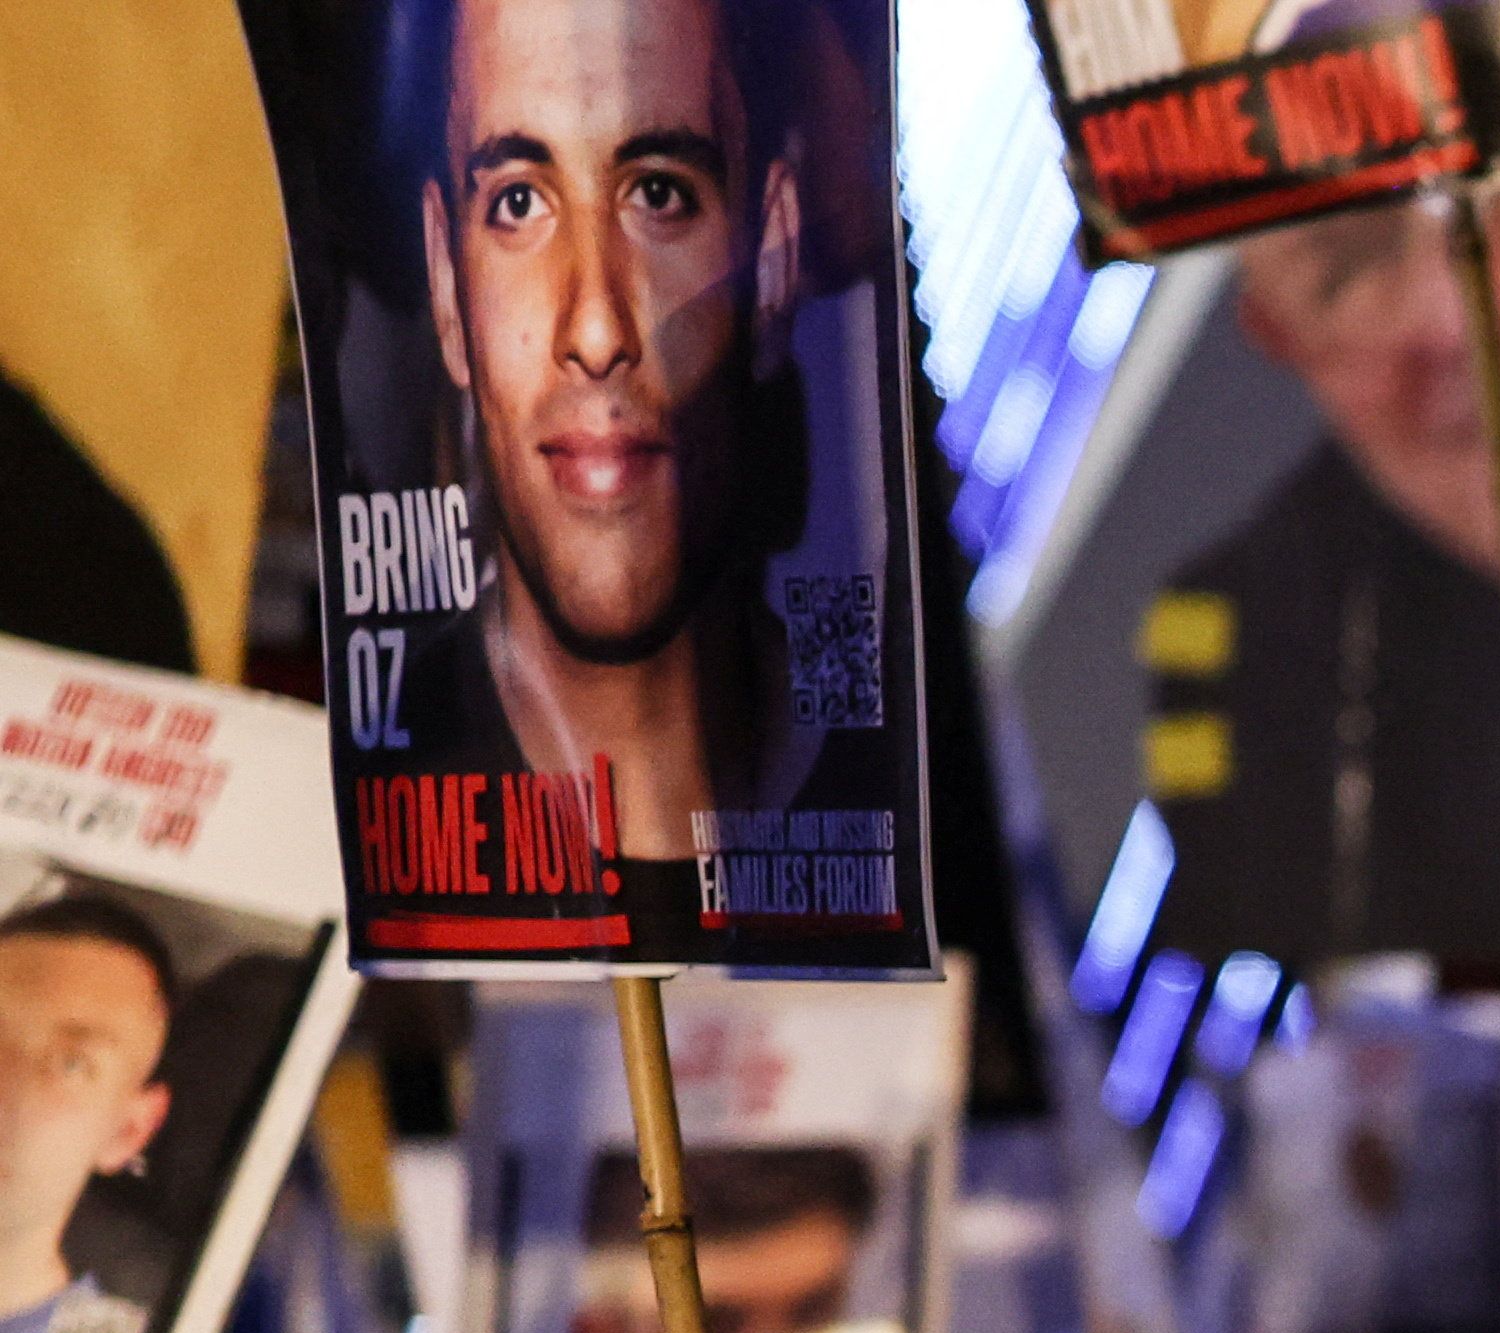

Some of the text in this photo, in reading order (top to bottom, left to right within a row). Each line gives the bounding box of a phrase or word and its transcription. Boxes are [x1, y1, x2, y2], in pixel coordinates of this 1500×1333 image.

[1081, 75, 1268, 207] HOME
[339, 483, 475, 616] BRING
[347, 628, 411, 750] OZ
[355, 772, 490, 895] HOME
[500, 752, 622, 897] NOW!
[697, 855, 897, 914] FAMILIES FORUM
